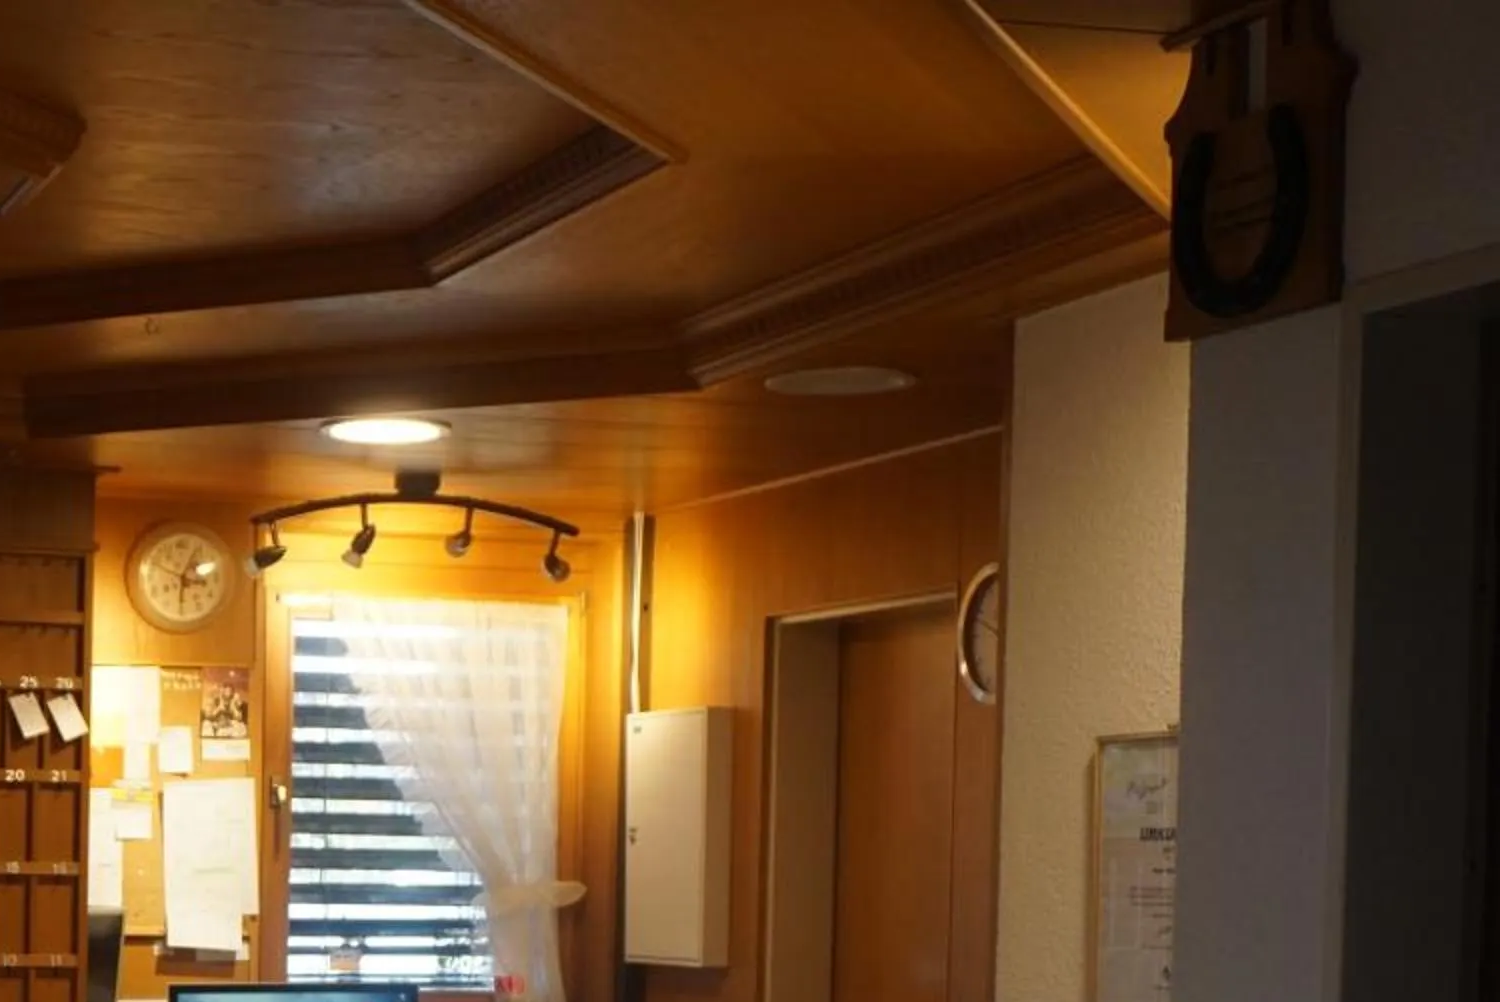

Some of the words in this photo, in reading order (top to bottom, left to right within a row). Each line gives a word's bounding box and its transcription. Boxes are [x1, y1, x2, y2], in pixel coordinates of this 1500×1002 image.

[19, 675, 38, 688] 25
[5, 769, 26, 782] 20
[51, 769, 68, 782] 21
